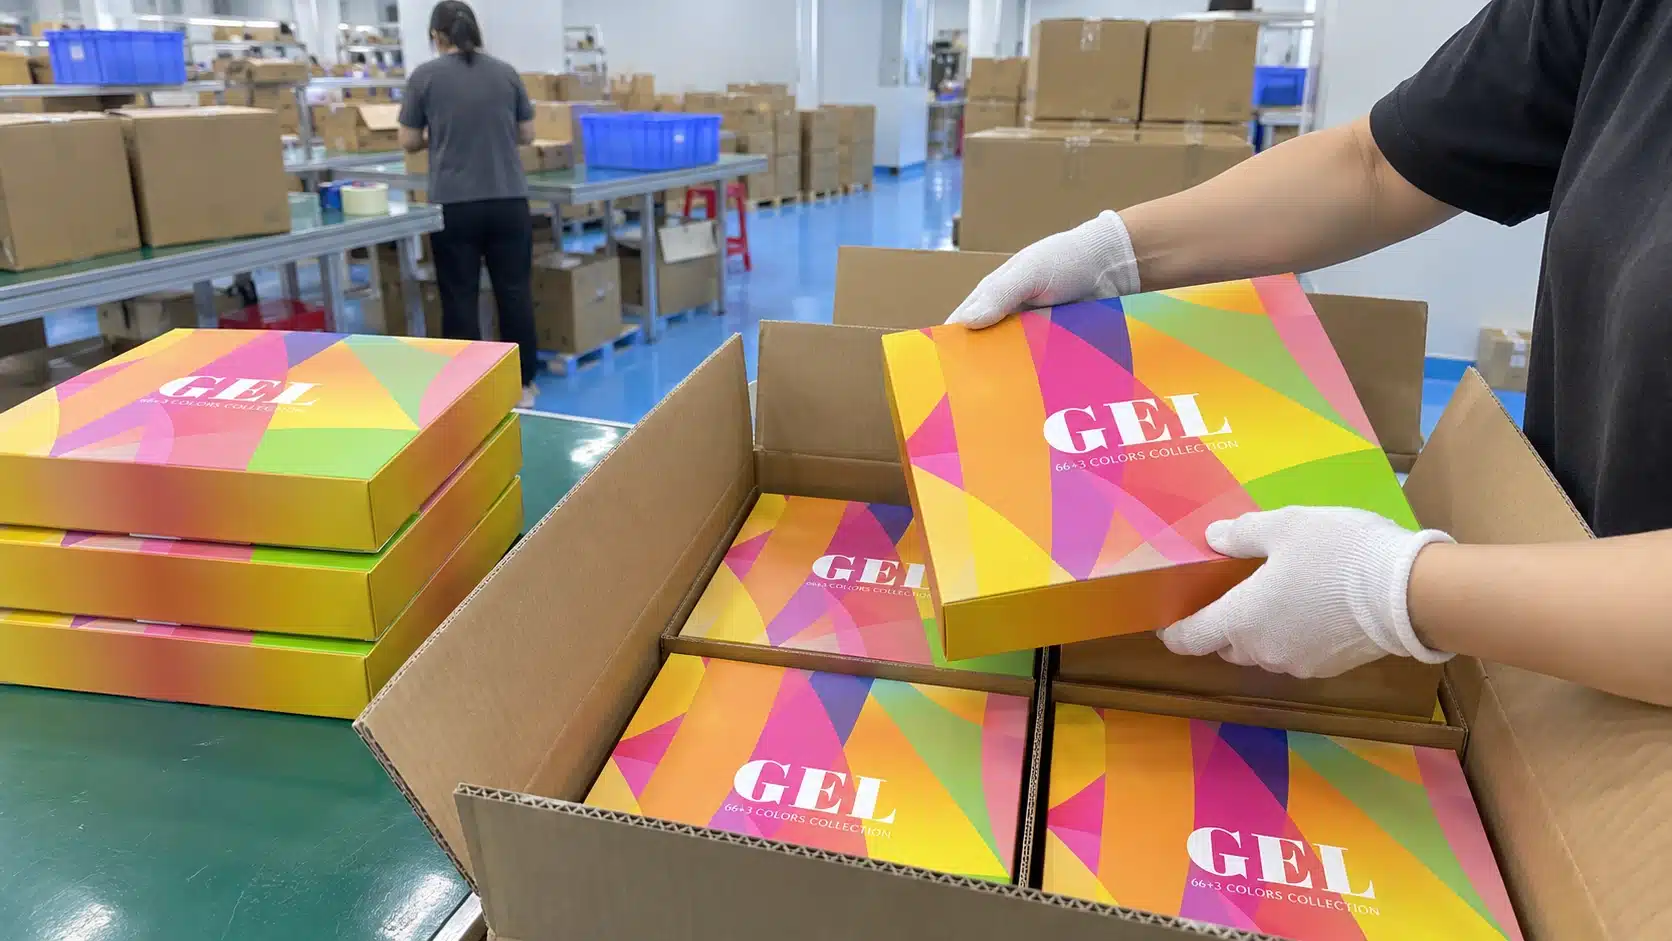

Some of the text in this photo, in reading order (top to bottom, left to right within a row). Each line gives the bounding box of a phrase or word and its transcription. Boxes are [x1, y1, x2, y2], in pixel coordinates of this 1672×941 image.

[158, 375, 324, 406] GEL
[1042, 392, 1233, 454] GEL
[1089, 451, 1146, 468] COLORS
[1149, 439, 1239, 460] COLLECTION
[733, 759, 897, 824] GEL
[755, 808, 805, 823] COLORS
[809, 817, 891, 839] COLLECTION
[1186, 826, 1376, 899] GEL
[1191, 877, 1380, 916] 66+3 COLORS COLLECTION
